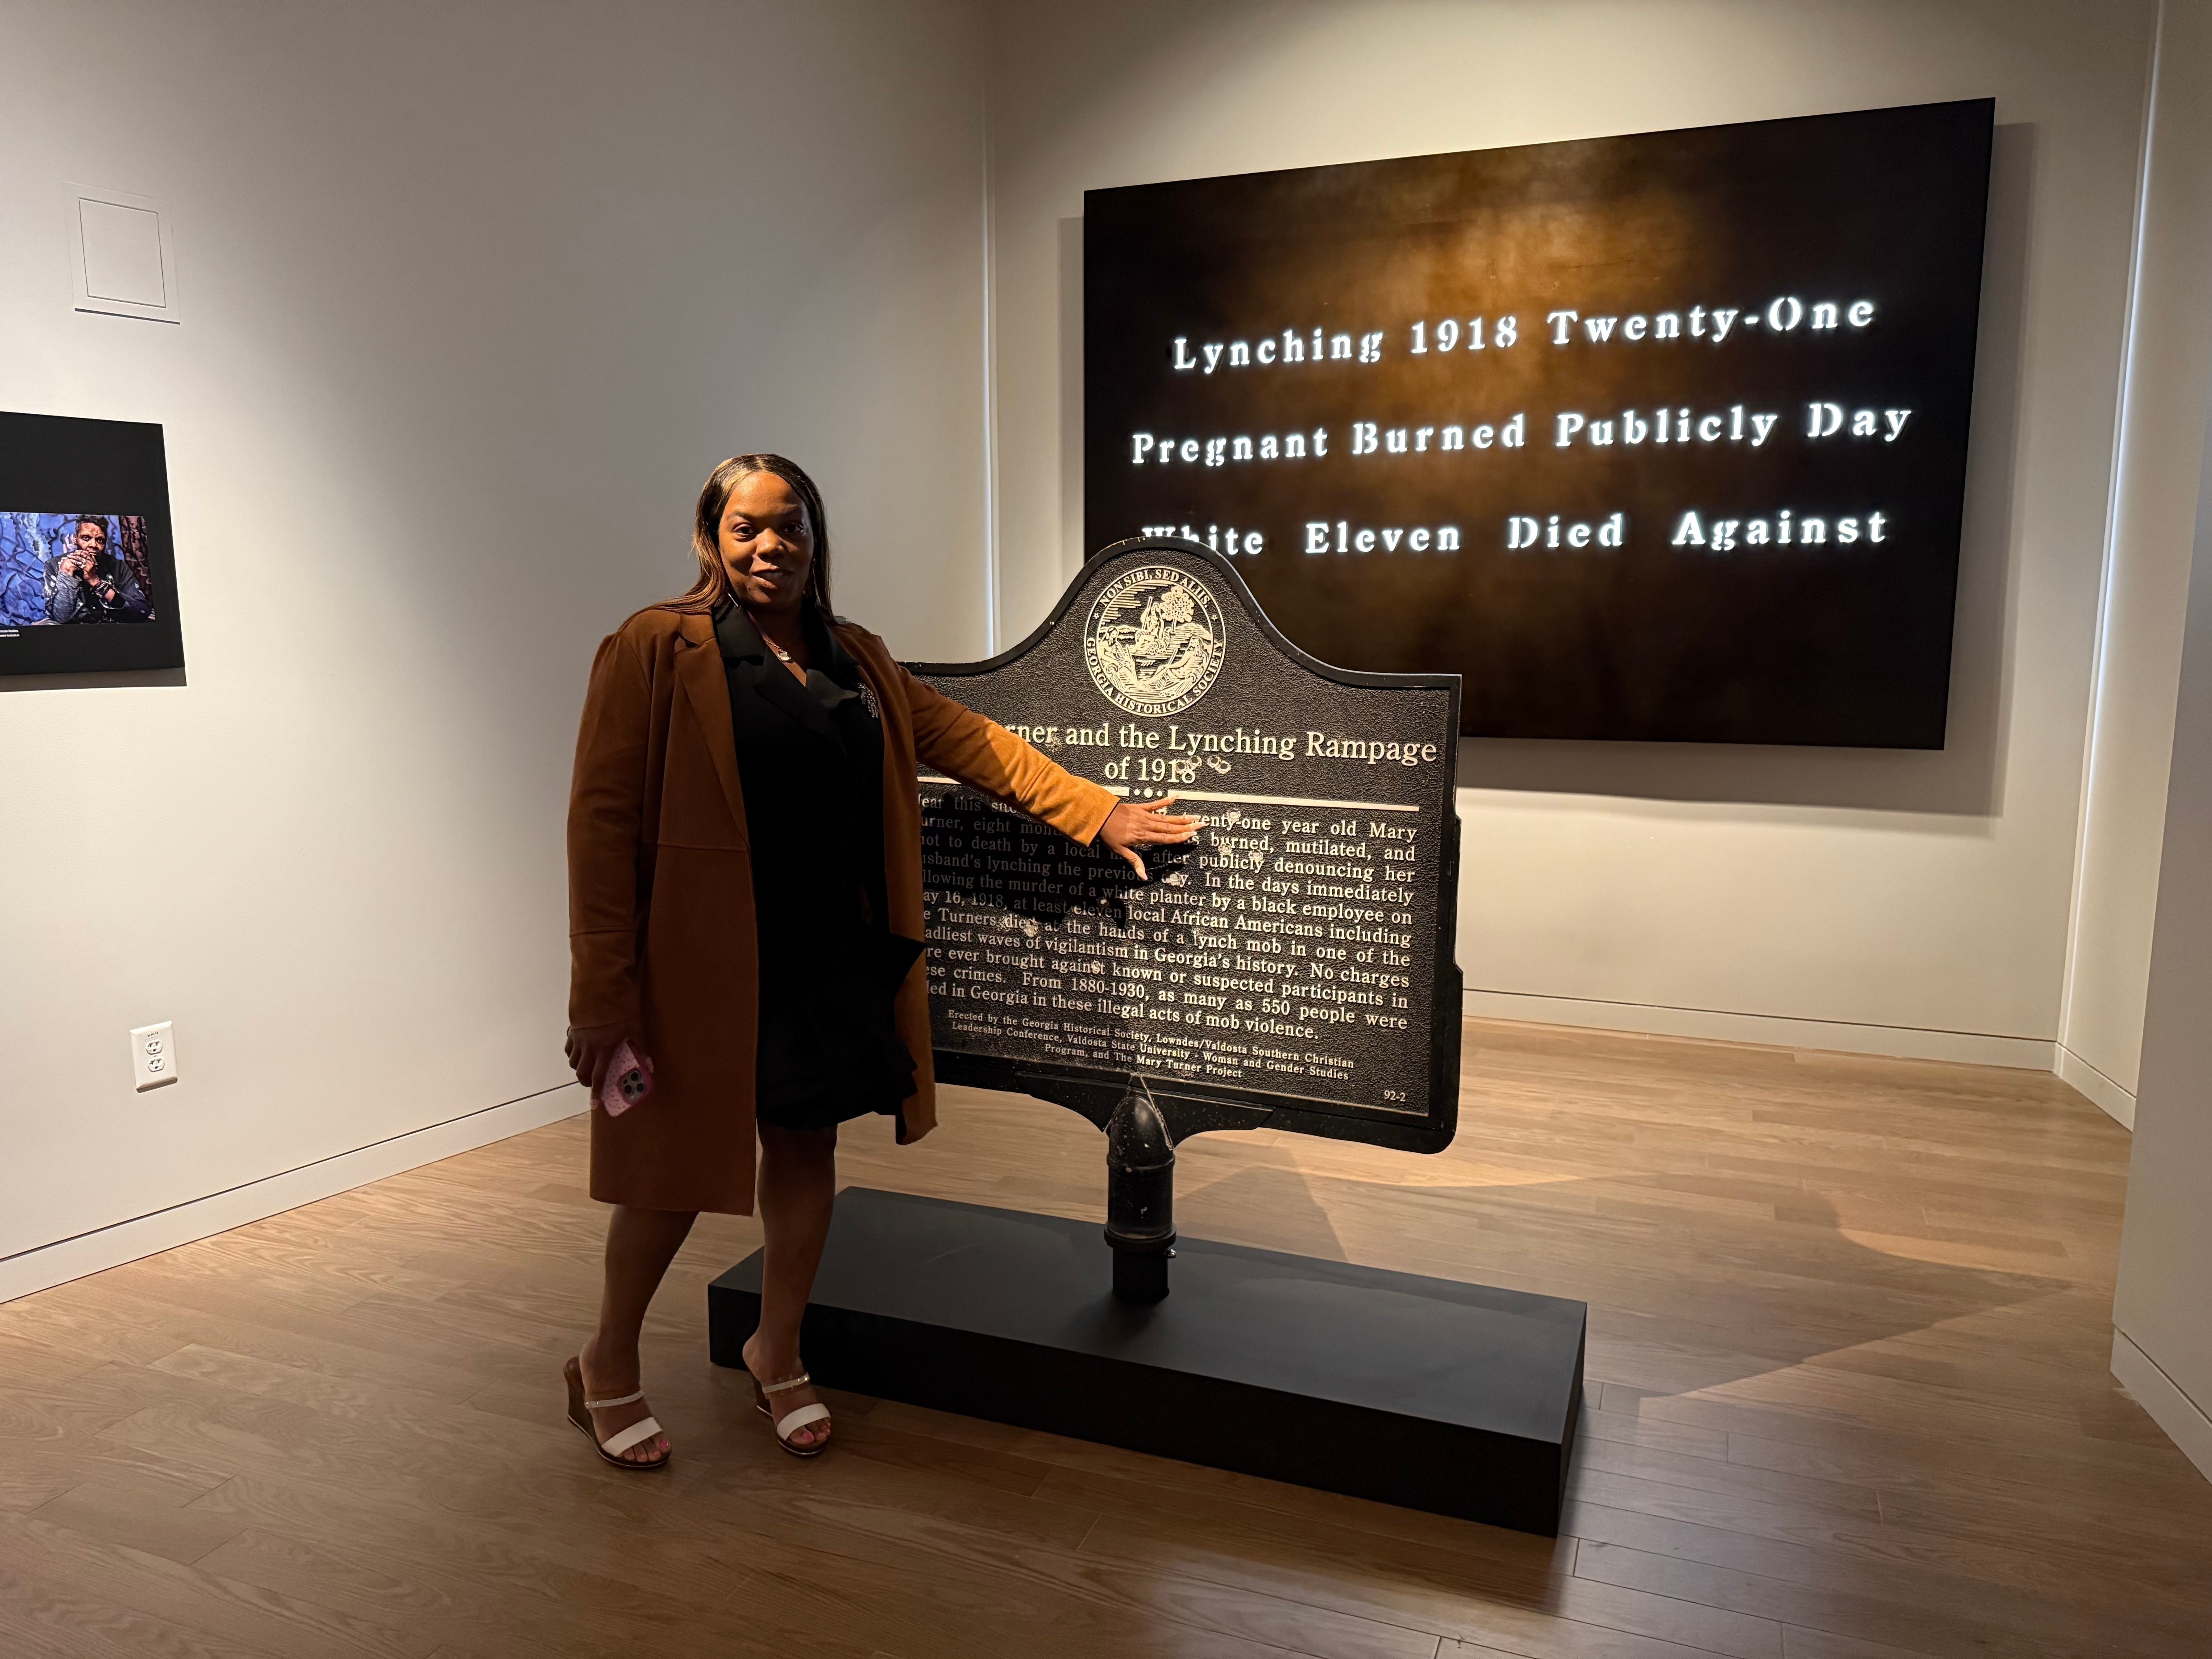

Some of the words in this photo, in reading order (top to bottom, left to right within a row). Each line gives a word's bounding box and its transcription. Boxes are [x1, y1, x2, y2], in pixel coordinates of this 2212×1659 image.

[1173, 328, 1384, 374] Lynching
[1410, 316, 1517, 354] 1918
[1547, 297, 1874, 344] Twenty-One
[1132, 428, 1328, 466] Pregnant
[1353, 414, 1525, 454] Burned
[1556, 405, 1778, 447] Publicly
[1807, 403, 1911, 442] Day
[1305, 522, 1460, 553] Eleven
[1508, 514, 1623, 549] Died
[1672, 511, 1886, 551] Against
[1100, 584, 1124, 608] NON
[1124, 570, 1152, 585] SIBI,
[1155, 569, 1180, 581] SED
[1087, 637, 1113, 697] GEORGIA
[1115, 694, 1193, 714] HISTORICAL
[1193, 640, 1223, 697] SOCIETY
[1005, 725, 1058, 743] rner
[1066, 722, 1110, 747] and
[1119, 723, 1159, 749] the
[1168, 726, 1297, 761] Lynching
[1305, 732, 1437, 766] Rampage
[1105, 756, 1131, 780] of
[919, 795, 944, 809] ear
[954, 797, 981, 811] this
[1189, 812, 1271, 831] enty-one
[1282, 821, 1319, 835] year
[1330, 820, 1356, 836] old
[1369, 822, 1417, 843] Mary
[921, 817, 963, 831] urner,
[973, 817, 1011, 833] eight
[1211, 832, 1274, 853] burned,
[1285, 840, 1372, 861] mutilated,
[1384, 846, 1415, 861] and
[949, 835, 963, 848] to
[971, 835, 1011, 852] death
[1021, 839, 1038, 856] by
[1047, 844, 1055, 855] a
[1065, 842, 1100, 858] local
[1152, 849, 1190, 864] after
[1199, 854, 1264, 873] publicly
[1274, 857, 1374, 882] denouncing
[1385, 866, 1415, 883] her
[988, 855, 1051, 876] lynching
[1058, 861, 1081, 876] the
[1205, 872, 1221, 887] In
[1228, 874, 1254, 890] the
[1262, 878, 1299, 896] days
[1307, 881, 1414, 906] immediately
[923, 869, 974, 889] llowing
[980, 874, 1003, 889] the
[1008, 879, 1063, 894] murder
[1069, 882, 1084, 895] of
[1089, 886, 1096, 897] a
[1102, 885, 1144, 901] white
[1150, 889, 1206, 906] planter
[1212, 893, 1231, 911] by
[1237, 898, 1245, 910] a
[1252, 896, 1297, 914] black
[1303, 903, 1384, 922] employee
[1391, 912, 1412, 925] on
[924, 891, 939, 904] ay
[945, 891, 965, 906] 16,
[972, 892, 1007, 910] 1918,
[1014, 898, 1027, 910] at
[1033, 897, 1068, 914] least
[1073, 901, 1122, 919] eleven
[1128, 906, 1165, 923] local
[1172, 910, 1228, 929] African
[1234, 915, 1323, 937] Americans
[1329, 924, 1412, 948] including
[925, 926, 973, 943] adliest
[977, 934, 1020, 948] waves
[1026, 936, 1041, 949] of
[1045, 937, 1128, 959] vigilantism
[1134, 945, 1149, 960] in
[1155, 948, 1230, 969] Georgia's
[1237, 955, 1298, 978] history.
[1310, 963, 1334, 979] No
[1341, 967, 1409, 988] charges
[938, 908, 996, 926] Turners
[1045, 919, 1059, 932] at
[1066, 920, 1091, 935] the
[1099, 922, 1144, 940] hands
[1154, 929, 1169, 942] of
[1176, 934, 1185, 945] a
[1193, 930, 1237, 950] lynch
[1247, 939, 1281, 954] mob
[1291, 941, 1306, 956] in
[1317, 947, 1347, 960] one
[1357, 948, 1374, 963] of
[1383, 951, 1410, 967] the
[949, 949, 979, 962] ever
[987, 950, 1045, 969] brought
[1051, 959, 1106, 974] against
[1113, 962, 1162, 981] known
[1170, 972, 1187, 984] or
[1195, 973, 1273, 993] suspected
[1282, 984, 1383, 1006] participants
[1392, 993, 1408, 1008] in
[954, 967, 1007, 984] crimes.
[1022, 972, 1062, 989] From
[1071, 978, 1149, 1002] 1880-1930,
[1158, 990, 1175, 1002] as
[1184, 994, 1227, 1011] many
[1235, 998, 1252, 1011] as
[1262, 999, 1290, 1015] 550
[1299, 1006, 1355, 1024] people
[1365, 1014, 1408, 1029] were
[948, 1010, 983, 1022] Erected
[988, 1014, 999, 1024] by
[1003, 1016, 1017, 1026] the
[1022, 1018, 1059, 1031] Georgia
[1063, 1022, 1110, 1036] Historical
[1115, 1029, 1151, 1042] Society,
[1157, 1034, 1247, 1054] Lowndes/Valdosta
[1252, 1047, 1300, 1061] Southern
[1305, 1053, 1354, 1068] Christian
[952, 983, 965, 998] in
[970, 986, 1028, 1005] Georgia
[1033, 992, 1046, 1007] in
[1052, 994, 1092, 1011] these
[1097, 998, 1144, 1019] illegal
[1149, 1007, 1180, 1022] acts
[1185, 1011, 1202, 1024] of
[1206, 1015, 1239, 1029] mob
[1245, 1017, 1318, 1039] violence.
[952, 1022, 1002, 1037] Leadership
[1006, 1028, 1063, 1043] Conference,
[1067, 1034, 1107, 1048] Valdosta
[1111, 1040, 1135, 1051] State
[1140, 1043, 1190, 1060] University
[1203, 1051, 1238, 1065] Woman
[1243, 1059, 1261, 1068] and
[1267, 1060, 1304, 1074] Gender
[1310, 1066, 1349, 1080] Studies
[1045, 1044, 1089, 1058] Program,
[1092, 1050, 1110, 1060] and
[1114, 1052, 1132, 1062] The
[1137, 1055, 1162, 1068] Mary
[1166, 1059, 1201, 1072] Turner
[1206, 1065, 1242, 1078] Project
[1384, 1090, 1406, 1102] 92-2
